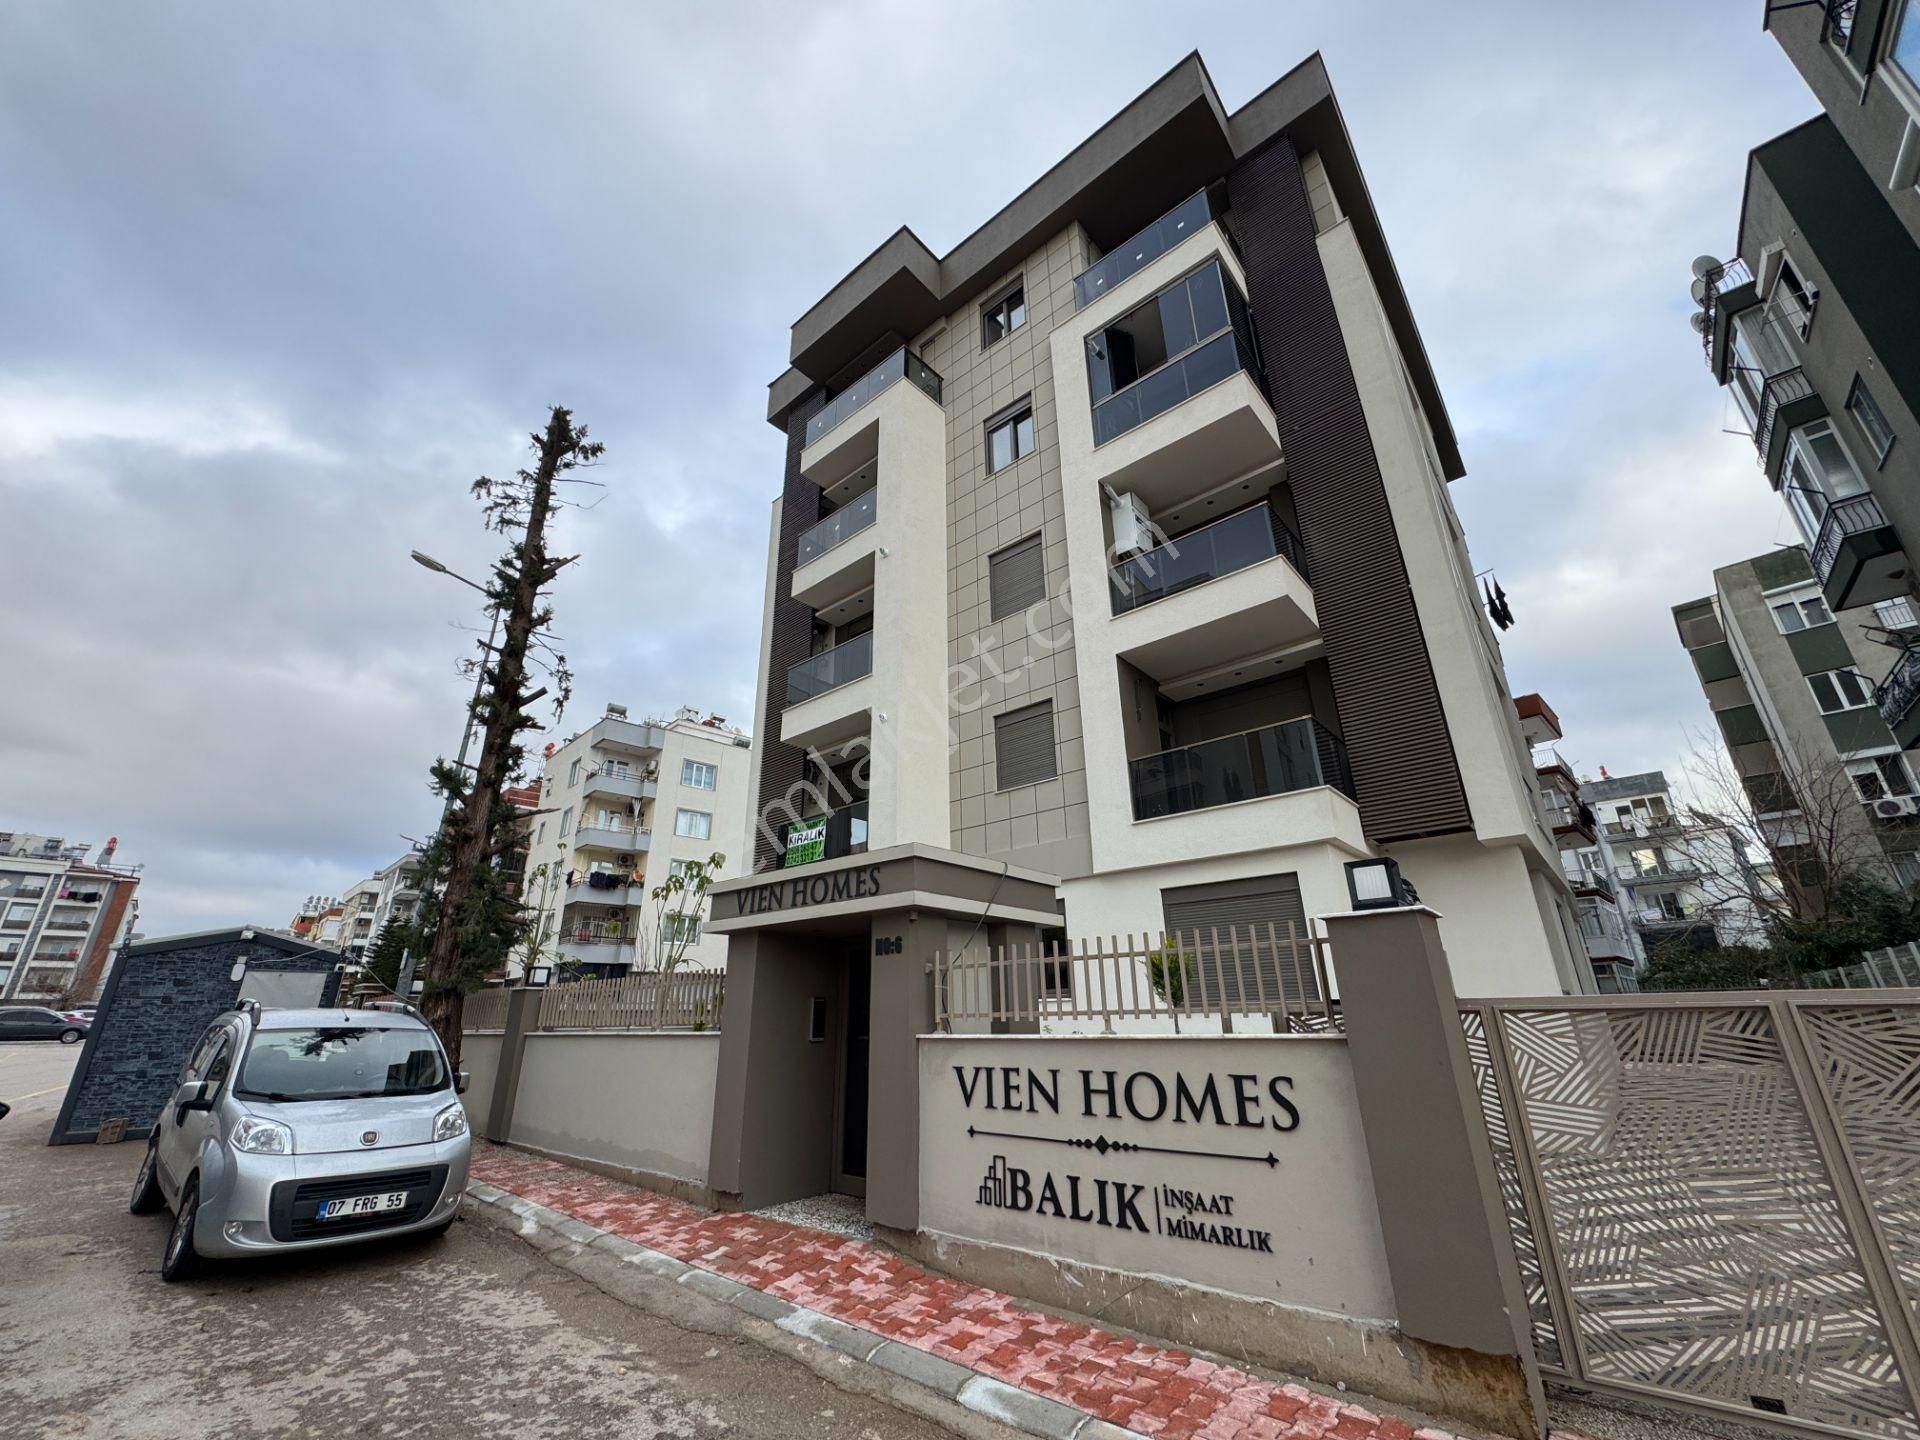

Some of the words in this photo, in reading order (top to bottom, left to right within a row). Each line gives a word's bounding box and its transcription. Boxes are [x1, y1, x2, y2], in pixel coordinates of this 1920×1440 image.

[737, 884, 784, 915] VIEN
[791, 866, 881, 907] HOMES
[953, 1066, 1060, 1114] VIEN
[1078, 1070, 1300, 1132] HOMES
[327, 1201, 346, 1215] 07
[352, 1196, 379, 1212] FRG
[387, 1193, 403, 1208] 55
[1006, 1167, 1150, 1234] BALIK
[1163, 1184, 1234, 1215] İNŞAAT
[1166, 1215, 1274, 1253] MİMARLIK
